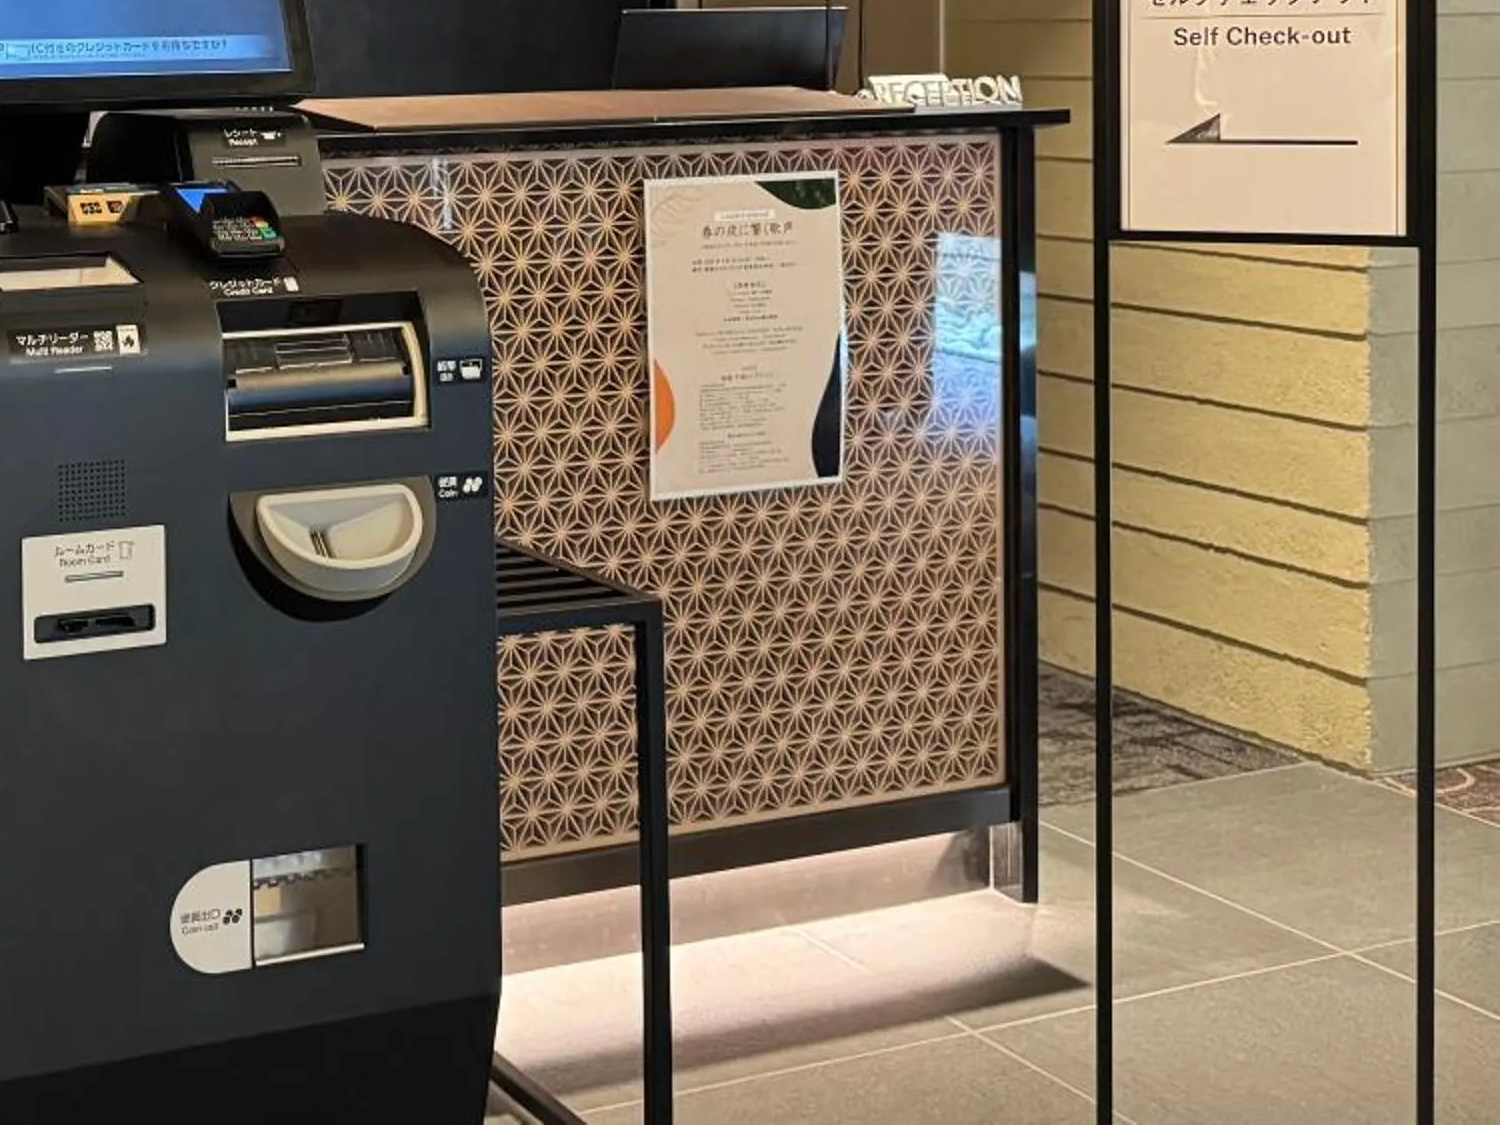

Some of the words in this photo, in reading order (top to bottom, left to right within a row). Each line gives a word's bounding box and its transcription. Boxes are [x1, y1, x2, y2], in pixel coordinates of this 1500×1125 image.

[1172, 26, 1220, 47] Self
[1226, 25, 1352, 46] Check-out
[15, 331, 90, 346] マルチリーダー
